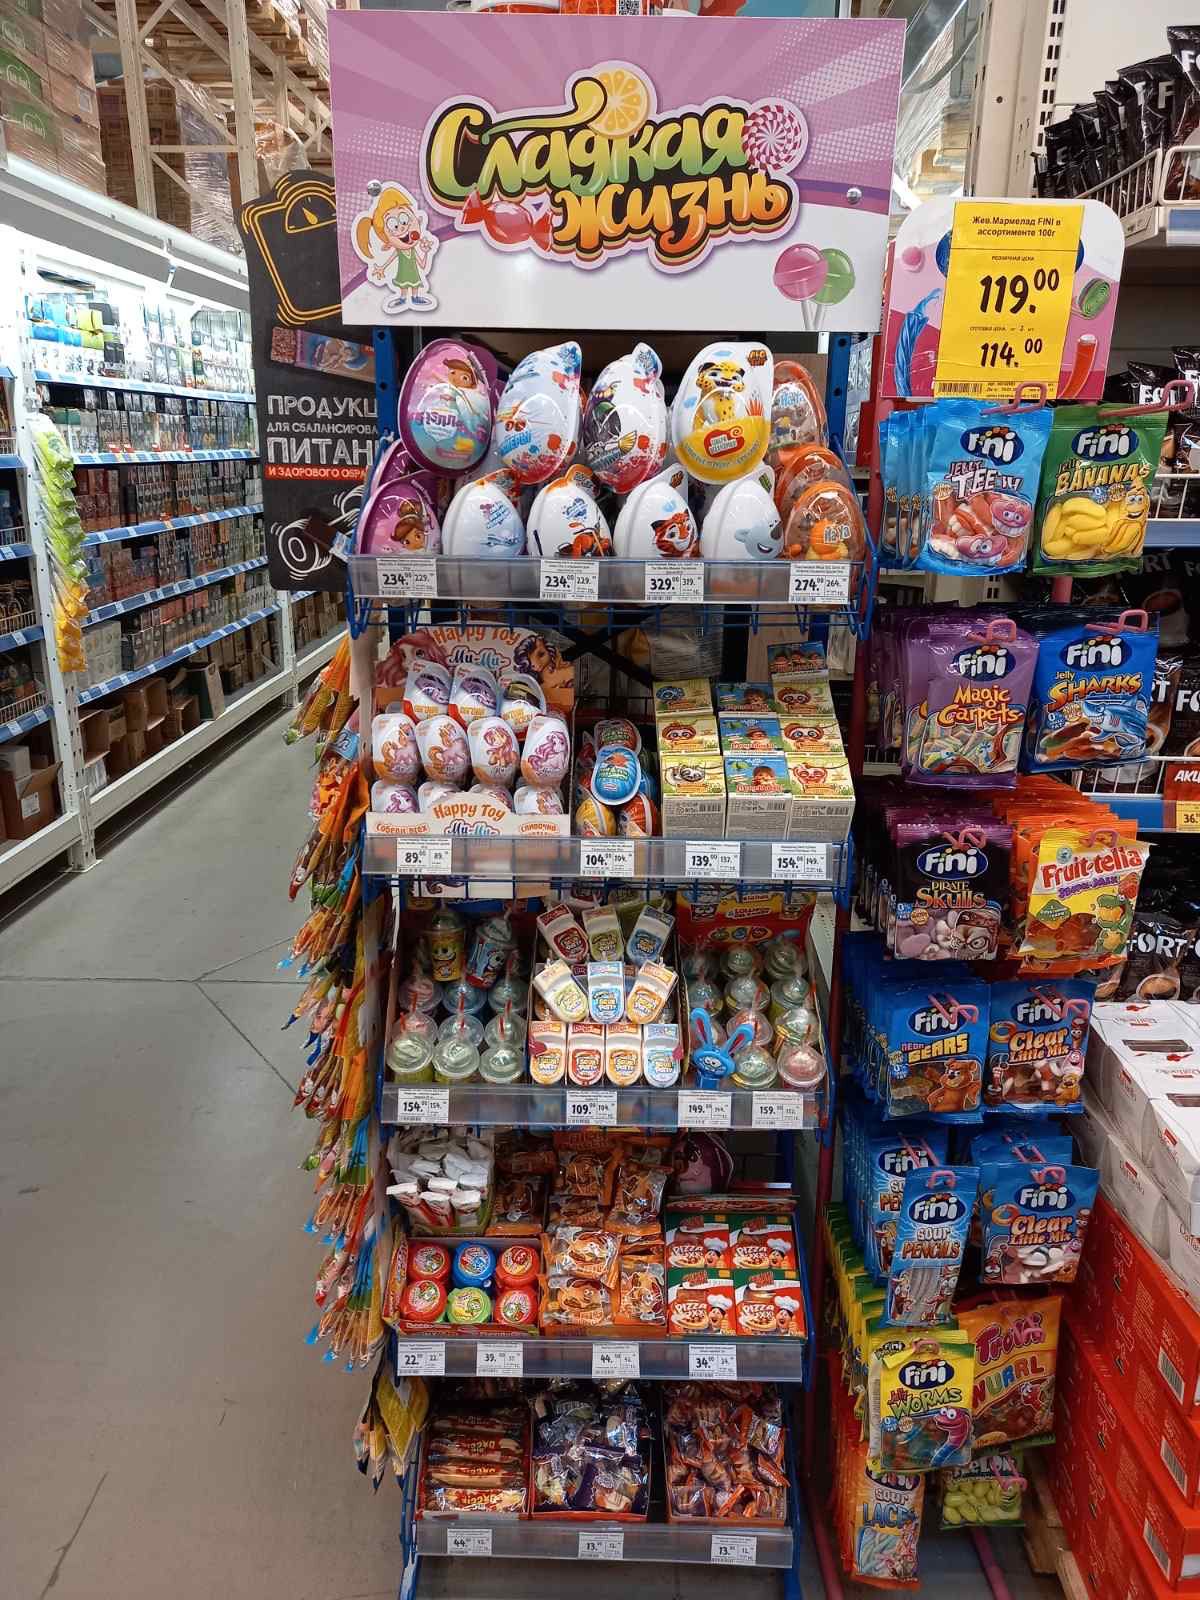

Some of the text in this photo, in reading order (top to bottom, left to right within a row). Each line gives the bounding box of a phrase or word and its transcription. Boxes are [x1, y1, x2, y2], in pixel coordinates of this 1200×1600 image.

[266, 422, 290, 433] ДЛЯ
[1076, 427, 1130, 457] Fini
[268, 466, 277, 477] И
[278, 467, 340, 478] ЗДОРОВОГО
[957, 648, 1008, 678] Fini
[1066, 637, 1122, 668] Fini
[1055, 671, 1076, 681] Jelly
[954, 684, 1012, 709] Magic
[1047, 672, 1142, 713] SHARKS
[936, 702, 1023, 731] Carpets
[432, 802, 506, 822] Happy Toy
[924, 847, 978, 874] Fini
[1041, 846, 1143, 889] Fruit-tella
[907, 1033, 970, 1064] BEARS
[1008, 1028, 1069, 1051] Clear
[913, 1197, 958, 1221] Fini
[1019, 1186, 1069, 1210] Fini
[1010, 1214, 1074, 1235] Clear
[672, 1245, 704, 1254] PIZZA
[736, 1246, 767, 1255] PIZZA
[901, 1240, 961, 1260] PENCILS
[1007, 1231, 1074, 1246] Little Mix
[675, 1302, 707, 1313] PIZZA
[742, 1304, 775, 1314] PIZZA
[904, 1360, 947, 1386] Fini
[887, 1387, 963, 1421] WORMS
